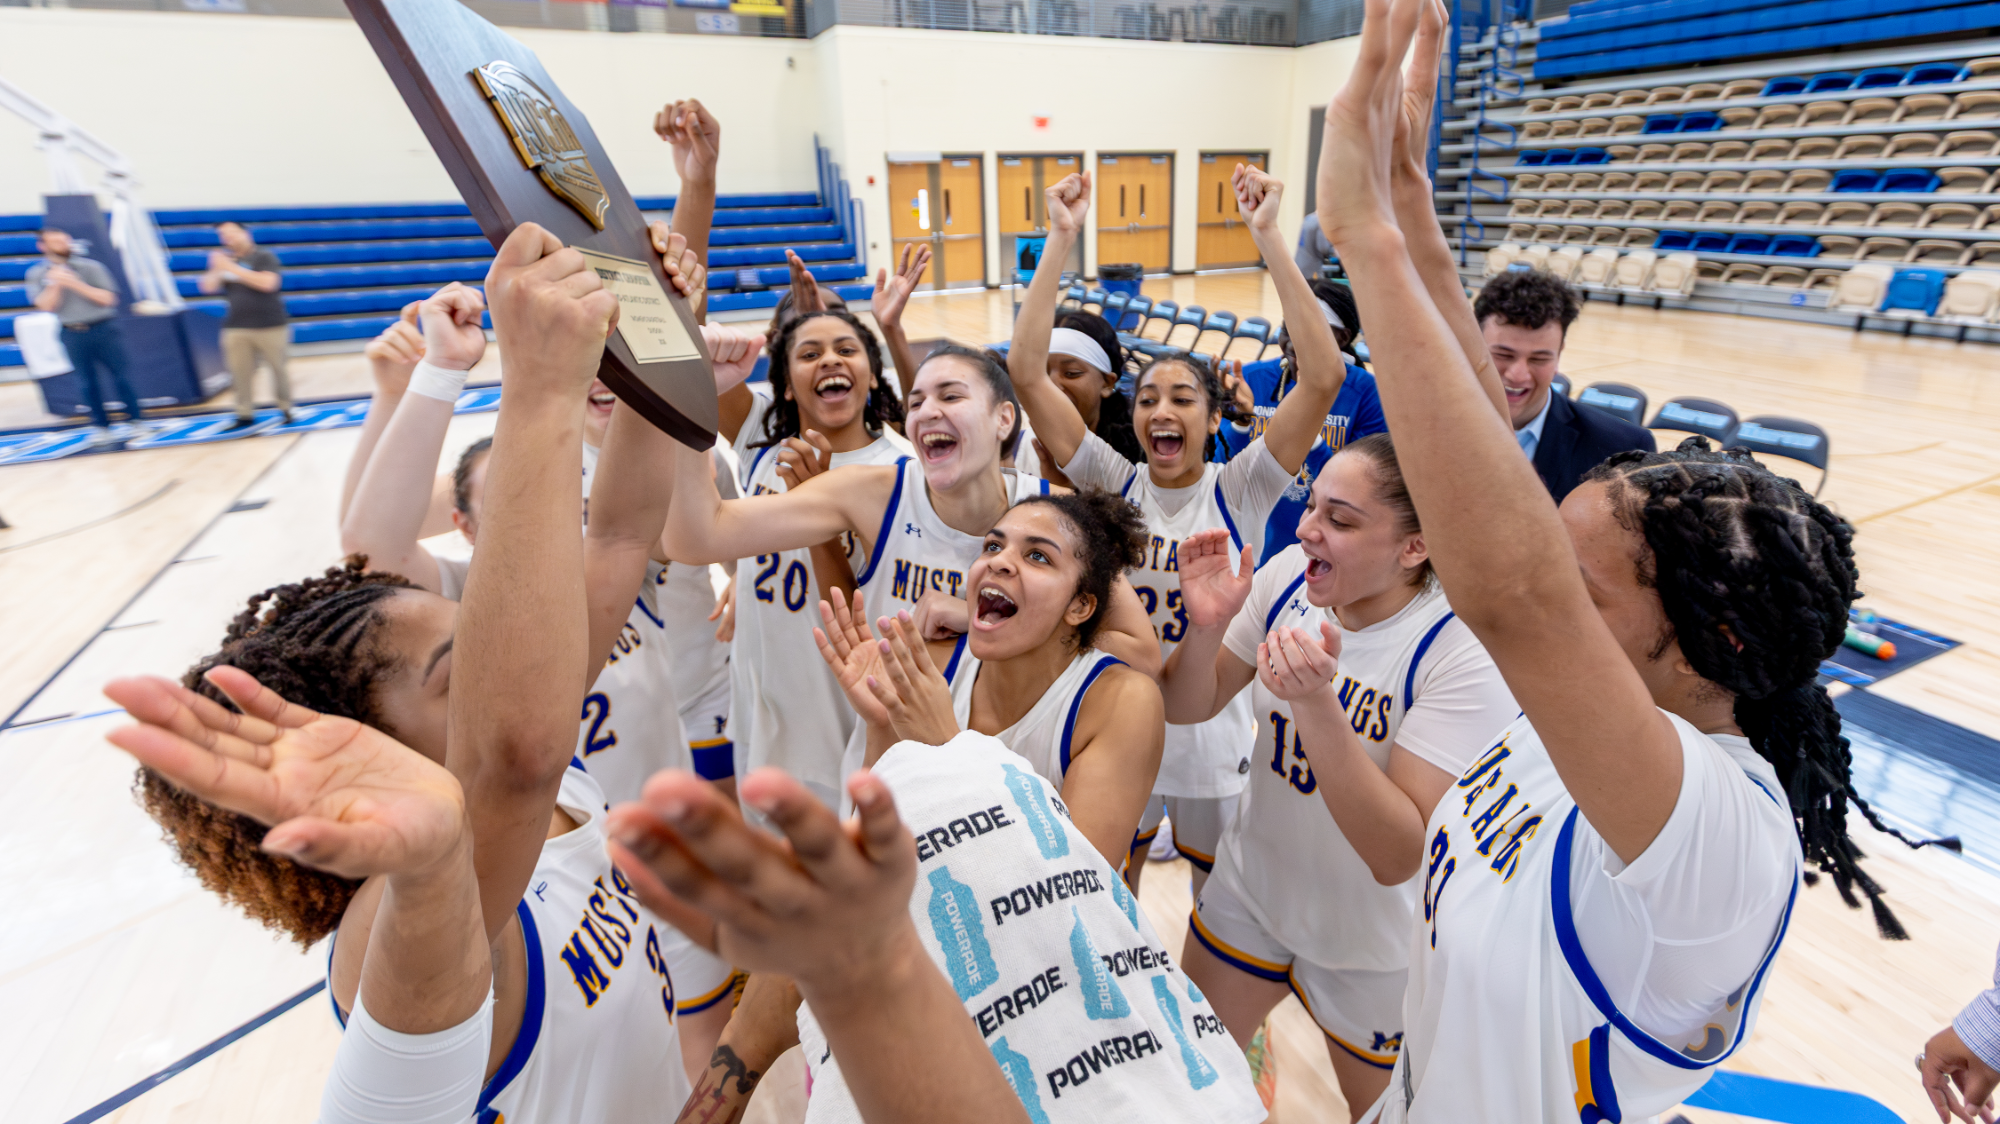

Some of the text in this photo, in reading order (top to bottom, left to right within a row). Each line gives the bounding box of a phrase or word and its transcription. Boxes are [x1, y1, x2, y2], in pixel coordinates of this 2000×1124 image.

[1323, 413, 1350, 427] SITY
[753, 550, 809, 613] 20
[1329, 671, 1394, 744] NGS
[1269, 709, 1318, 796] 15
[1015, 773, 1059, 850] POWERADE
[989, 868, 1105, 927] POWERAD
[940, 890, 983, 986] POWERADE
[971, 965, 1068, 1039] ERADE.
